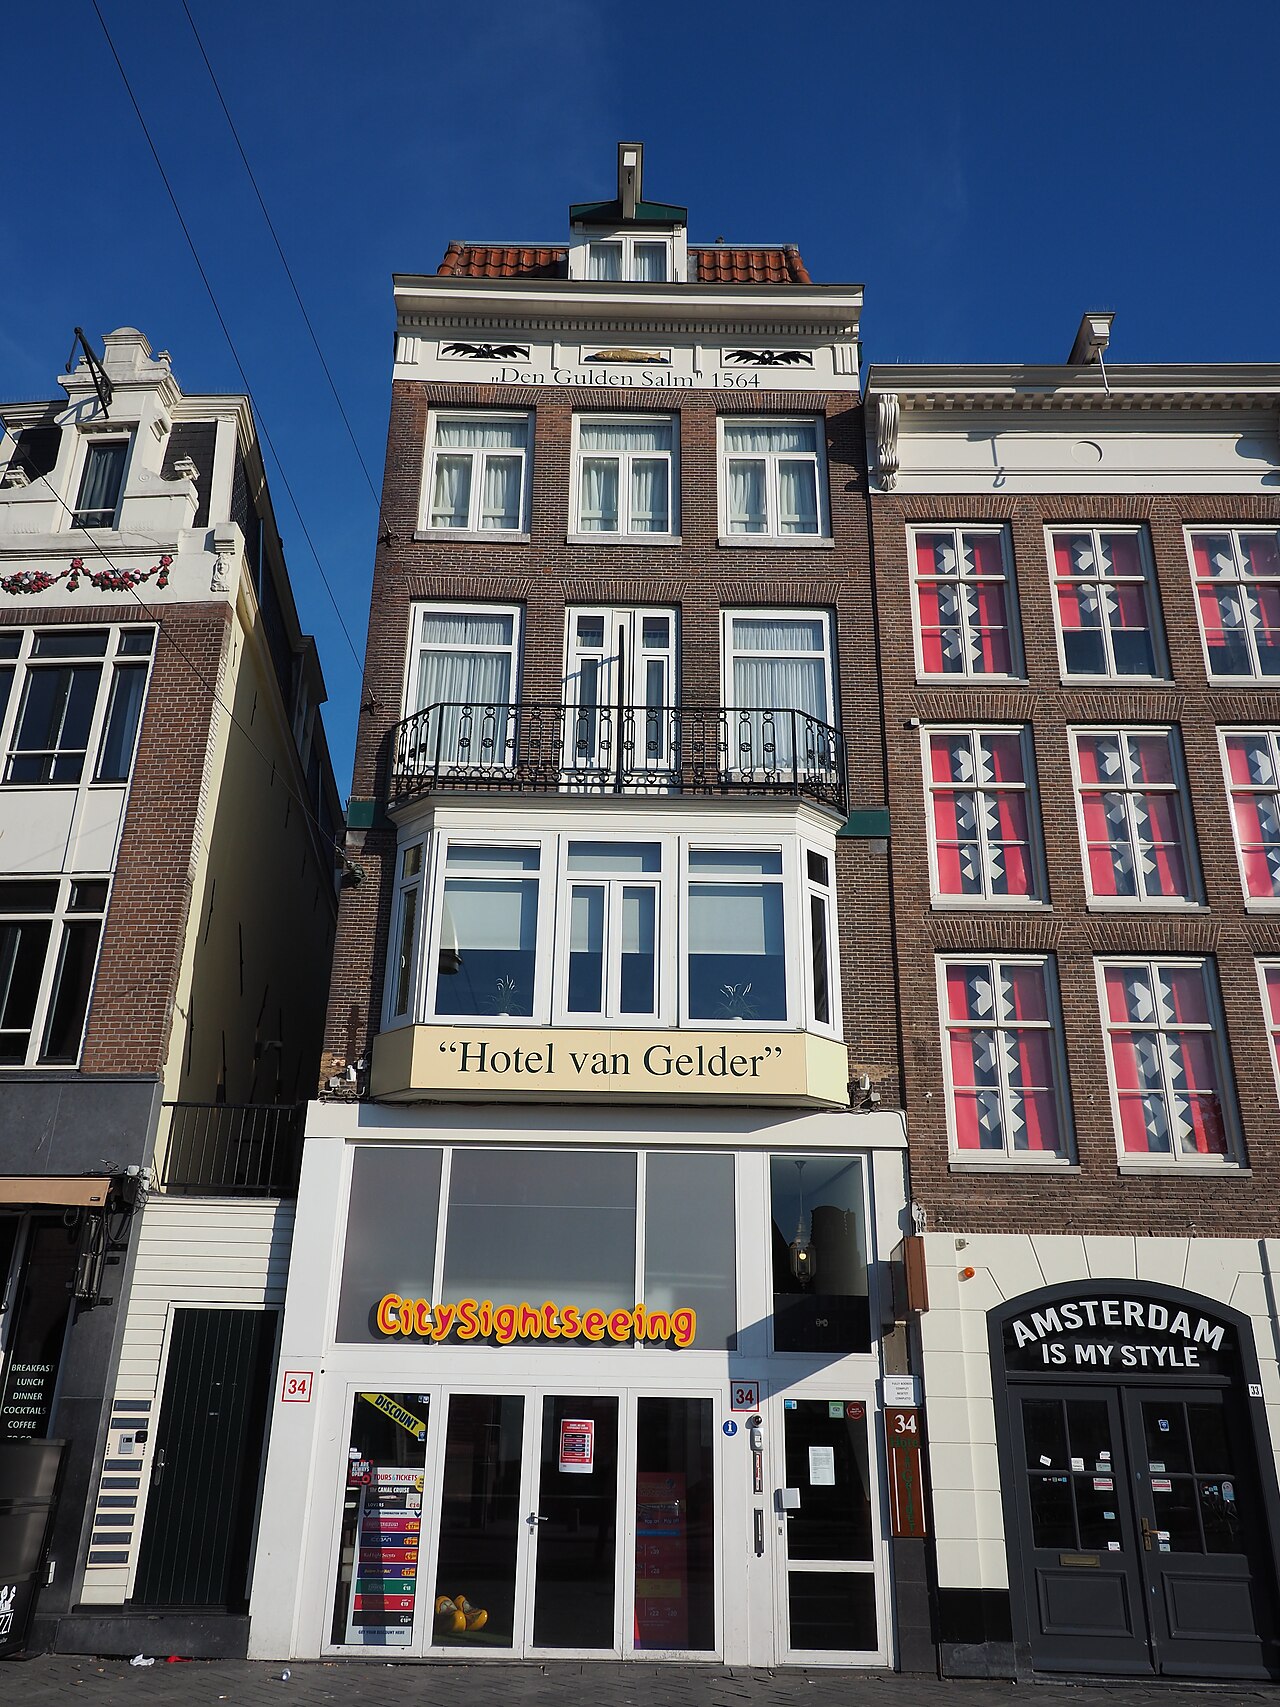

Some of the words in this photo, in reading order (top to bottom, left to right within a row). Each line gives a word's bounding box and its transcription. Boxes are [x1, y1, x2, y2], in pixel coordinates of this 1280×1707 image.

[553, 368, 633, 386] Gulden
[711, 372, 761, 388] 1564
[568, 1050, 631, 1076] van
[1012, 1300, 1225, 1351] AMSTERDAM
[1041, 1343, 1067, 1364] IS
[1074, 1344, 1115, 1366] MY
[1120, 1345, 1200, 1367] STYLE
[11, 1364, 55, 1372] BREAKFAST
[16, 1378, 45, 1386] LUNCH
[287, 1379, 307, 1395] 34
[12, 1392, 43, 1400] DINNER
[735, 1389, 754, 1404] 34
[1250, 1385, 1260, 1396] 33
[3, 1406, 47, 1415] COCKTAILS
[374, 1395, 419, 1431] DISCOUNT
[7, 1420, 37, 1429] COFFEE
[894, 1414, 917, 1434] 34
